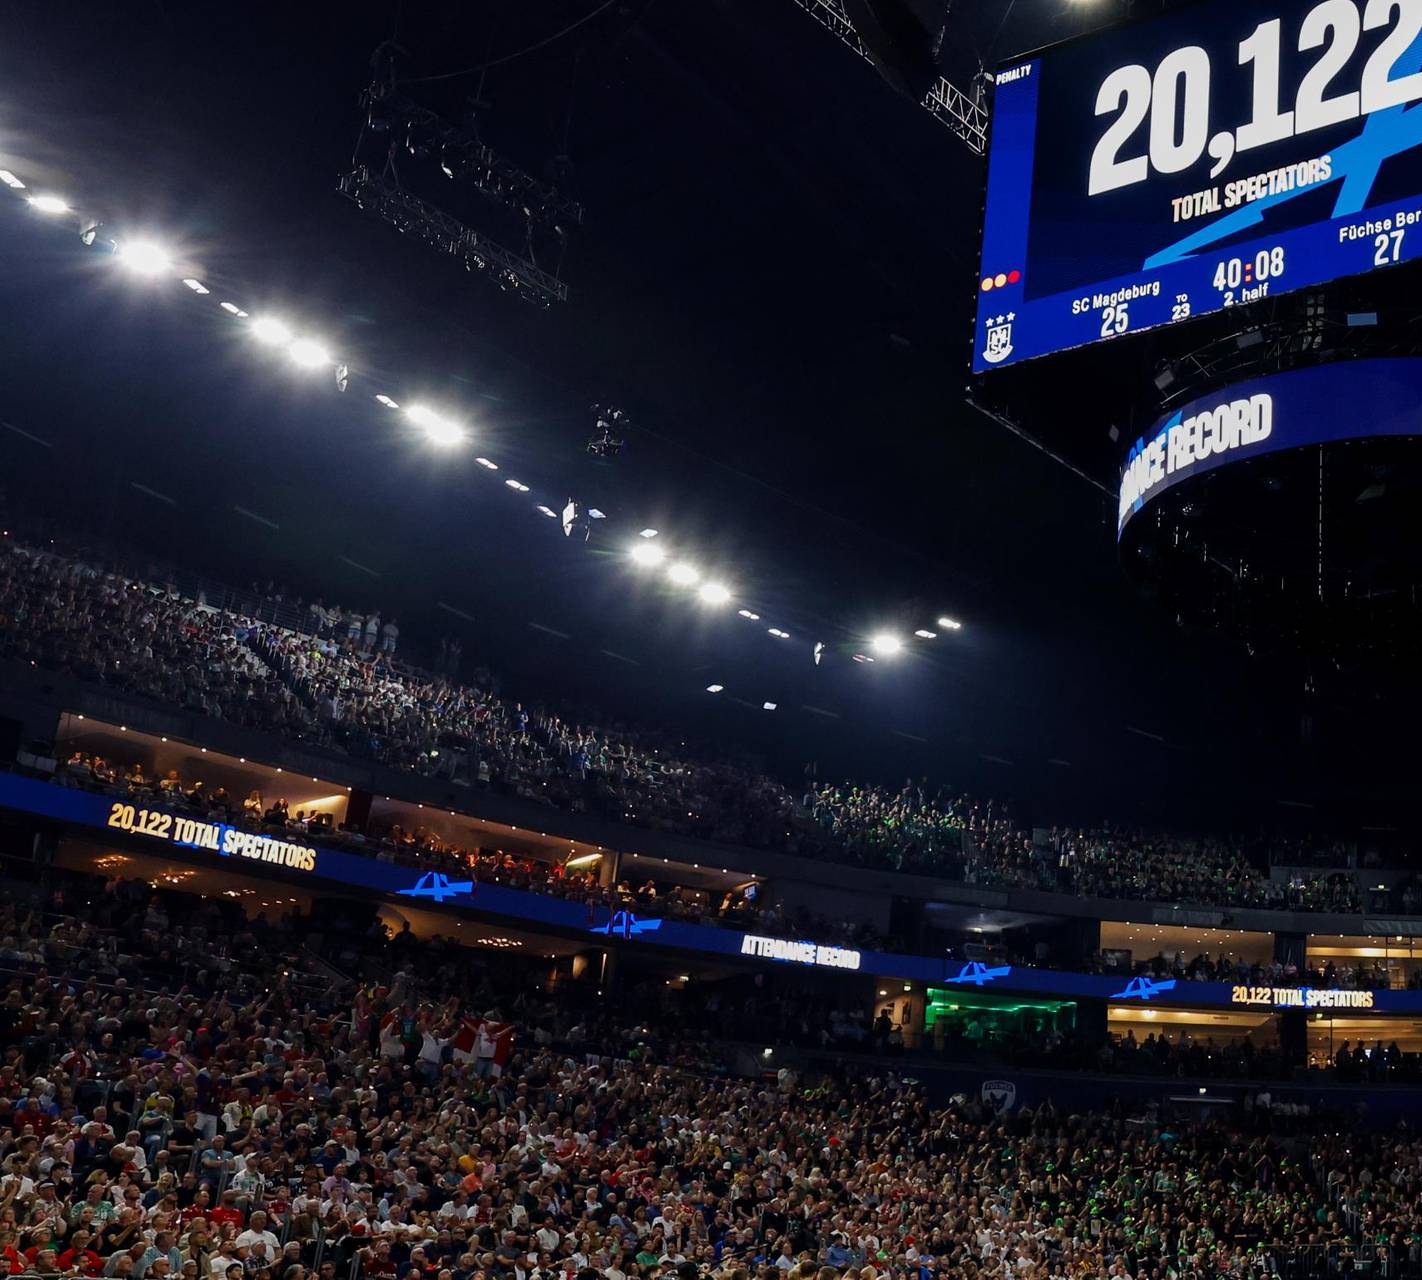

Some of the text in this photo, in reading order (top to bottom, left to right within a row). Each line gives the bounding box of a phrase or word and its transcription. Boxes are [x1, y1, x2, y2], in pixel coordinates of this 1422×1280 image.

[996, 64, 1032, 86] PENALTY
[1172, 155, 1333, 223] TOTAL SPECTATORS
[1339, 219, 1392, 243] Füchse
[1373, 229, 1405, 266] 27
[1213, 246, 1284, 291] 40:08
[1072, 281, 1160, 315] SC Magdeburg
[1176, 293, 1188, 303] TO
[1223, 282, 1270, 307] 2. half
[1101, 303, 1129, 337] 25
[1172, 302, 1190, 320] 23
[1167, 393, 1272, 474] RECORD
[108, 803, 317, 871] 20,122 TOTAL SPECTATORS
[741, 934, 817, 963] ATTENDANCE
[1232, 986, 1374, 1008] 20,122 TOTAL SPECTATORS
